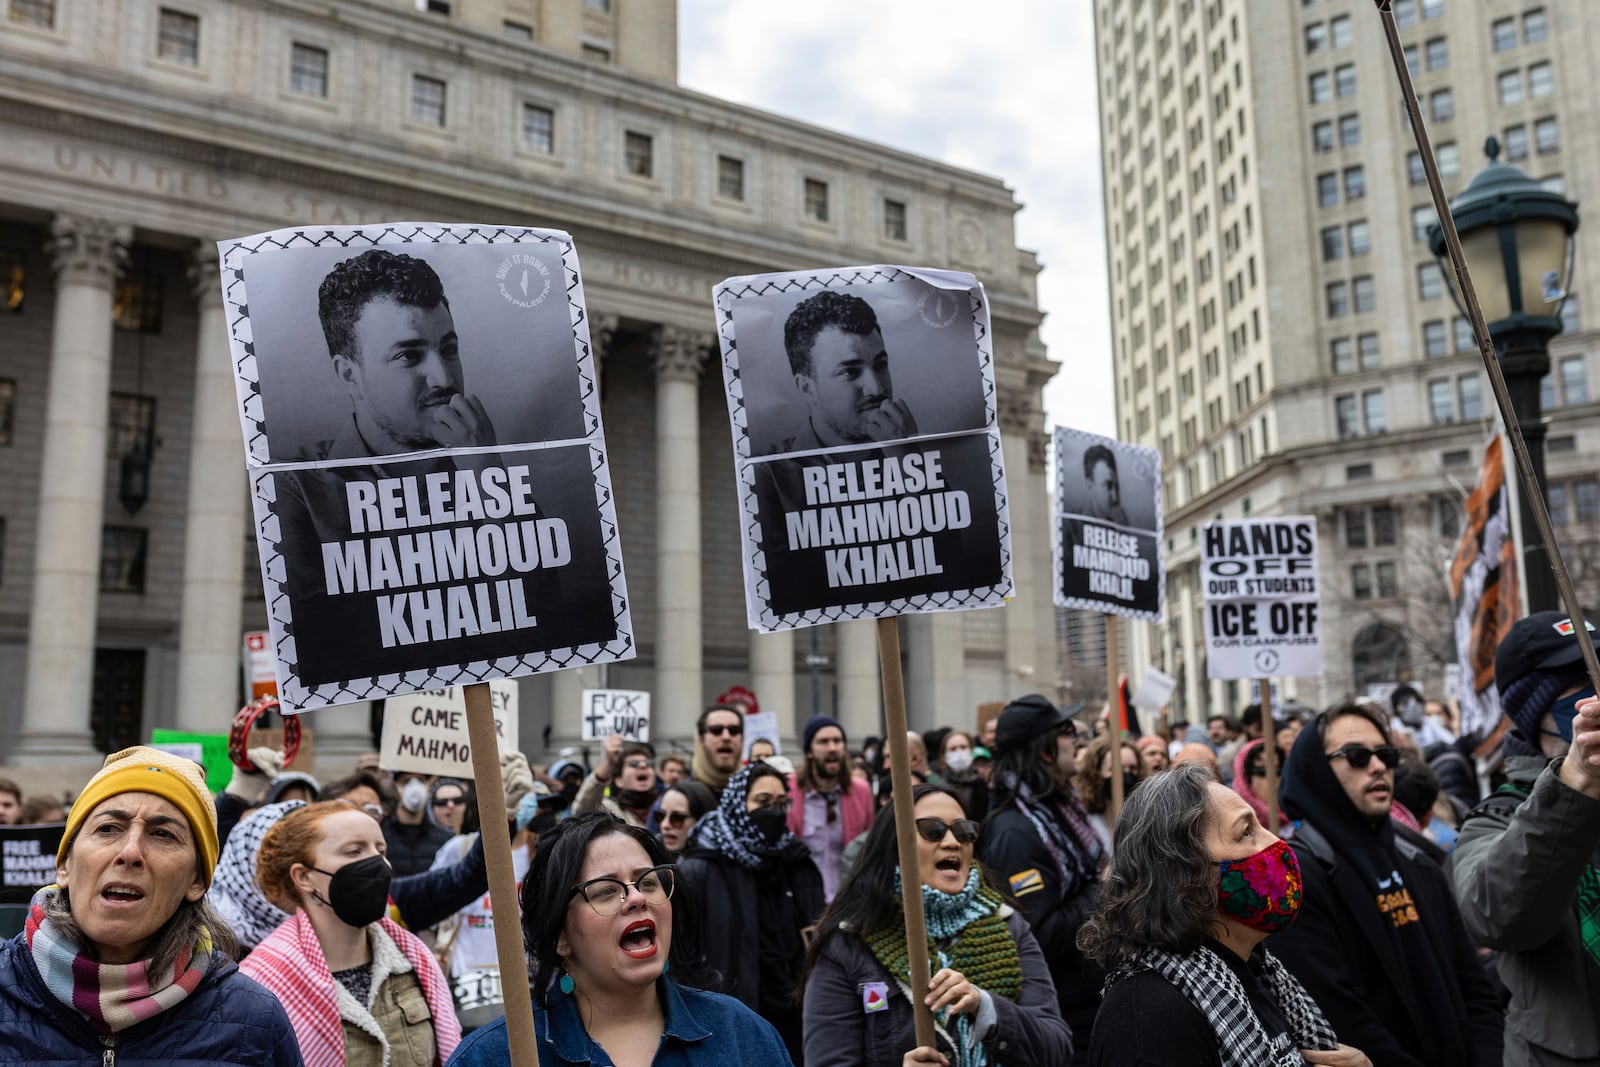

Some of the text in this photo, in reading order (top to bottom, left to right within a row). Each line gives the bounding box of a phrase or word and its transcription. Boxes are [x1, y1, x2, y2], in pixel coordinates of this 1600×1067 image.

[54, 145, 229, 199] UNITED
[802, 450, 945, 506] RELEASE
[345, 464, 536, 534] RELEASE
[785, 490, 971, 551] MAHMOUD
[321, 517, 572, 596] MAHMOUD
[1082, 523, 1139, 558] RELEASE
[1205, 522, 1314, 558] HANDS
[824, 536, 944, 588] KHALIL
[1072, 544, 1150, 581] MAHMOUD
[1209, 558, 1313, 577] OFF
[1088, 569, 1135, 601] KHALIL
[1209, 577, 1316, 595] OUR STUDENTS
[376, 577, 537, 649] KHALIL
[1211, 602, 1318, 638] ICE OFF
[411, 706, 463, 731] CAME
[592, 694, 641, 716] FUCK
[397, 734, 470, 763] MAHMO
